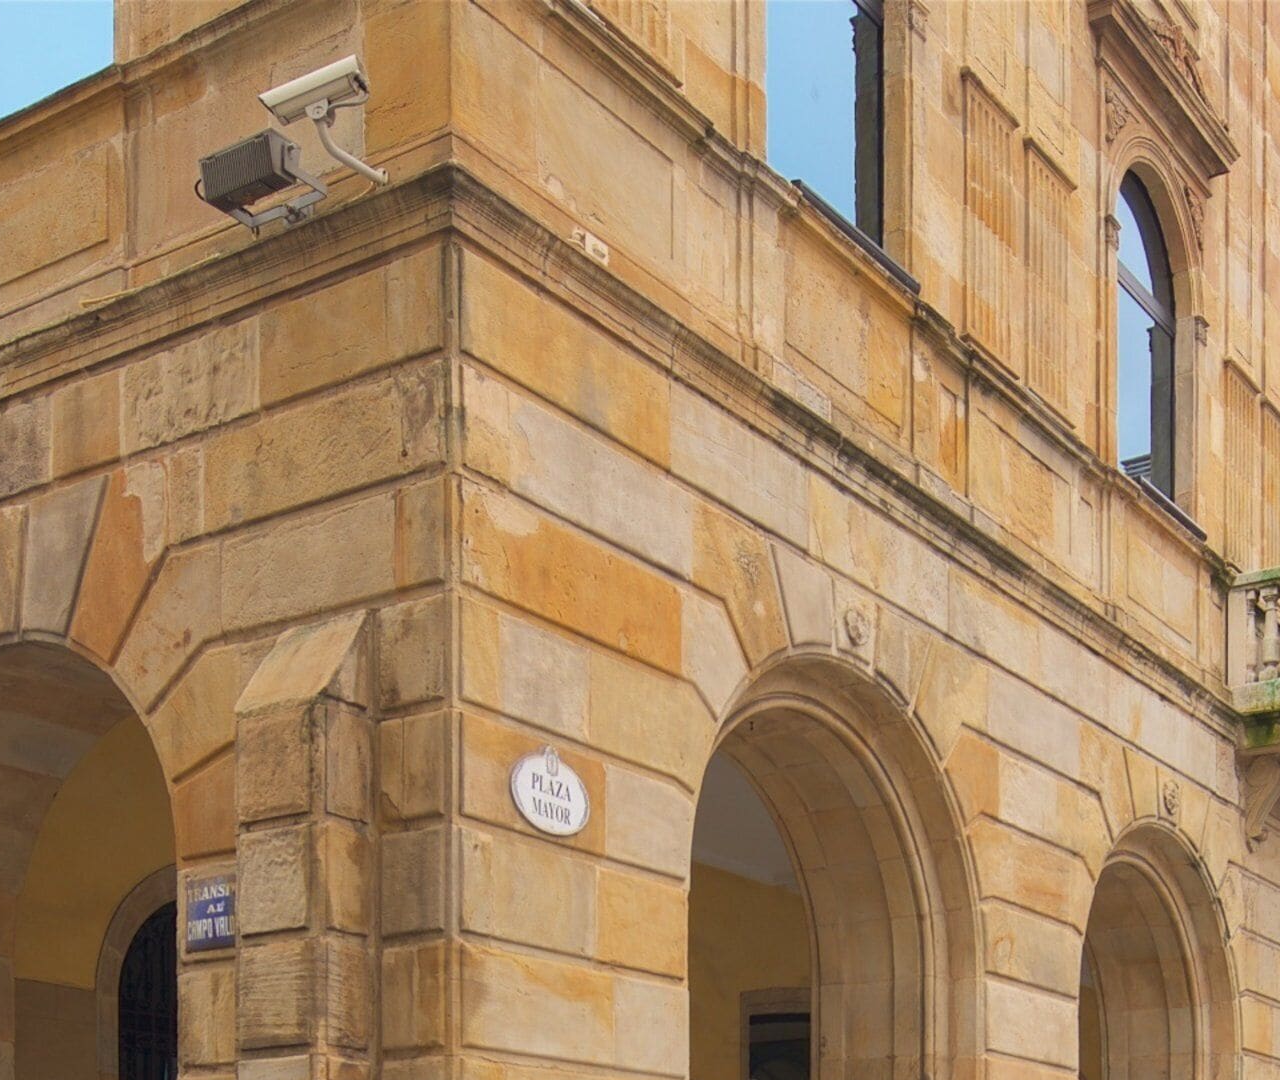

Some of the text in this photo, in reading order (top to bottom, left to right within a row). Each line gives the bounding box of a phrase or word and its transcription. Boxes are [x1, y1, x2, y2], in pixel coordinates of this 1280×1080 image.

[532, 772, 571, 802] PLAZA
[532, 796, 571, 825] MAYOR
[187, 918, 213, 941] CAMPO
